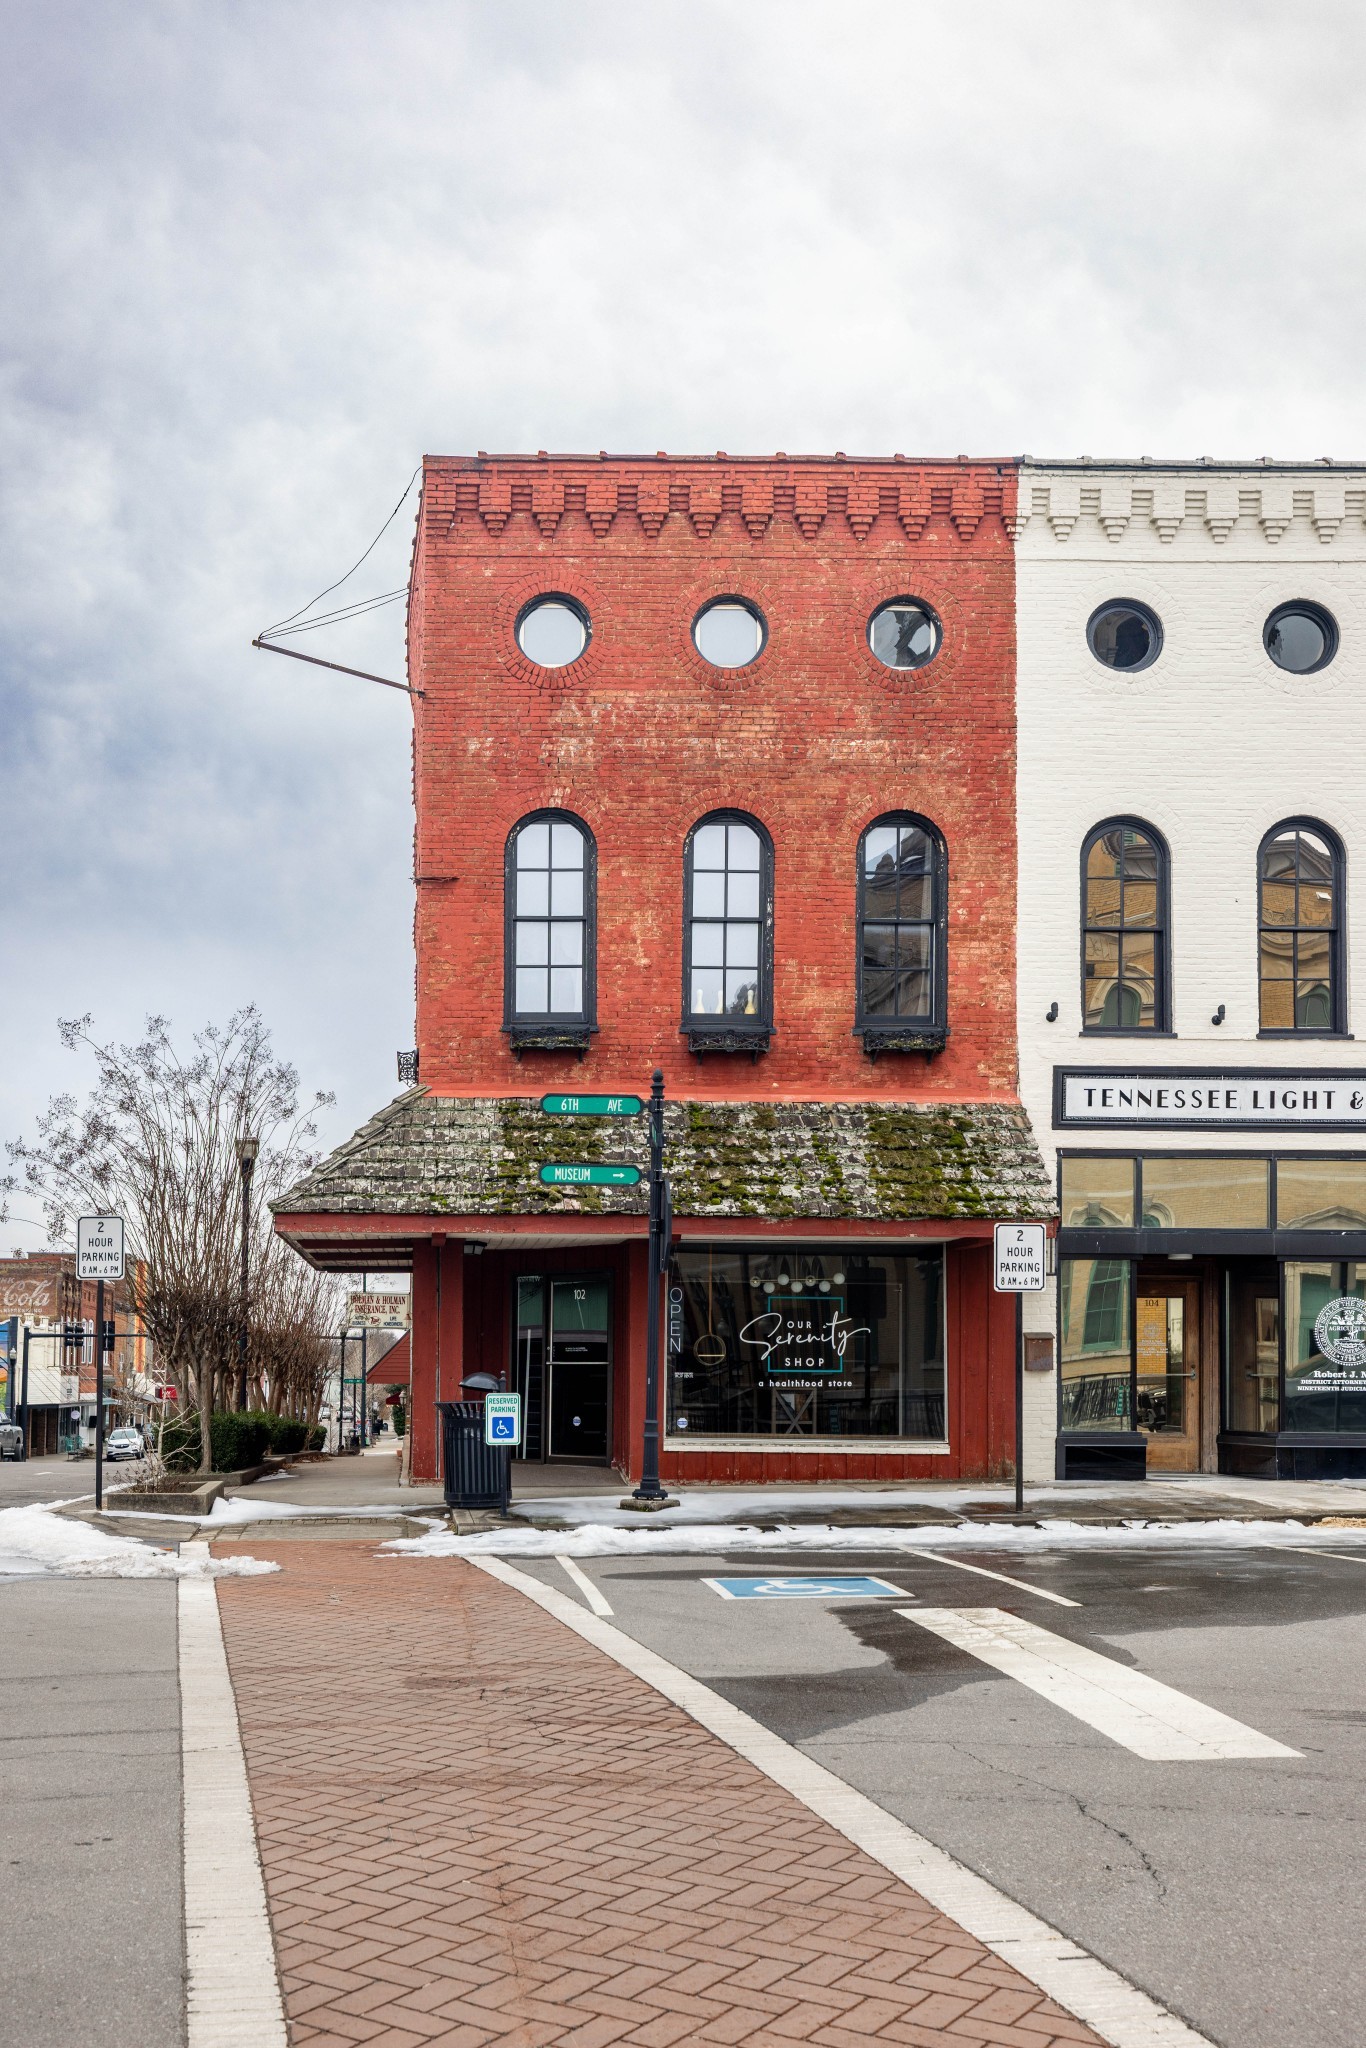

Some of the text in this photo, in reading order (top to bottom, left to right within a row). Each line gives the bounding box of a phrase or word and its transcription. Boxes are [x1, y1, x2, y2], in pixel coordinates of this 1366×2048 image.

[1084, 1088, 1364, 1110] TENNESSEE LIGHT &
[561, 1098, 623, 1112] 6TH AVE
[554, 1168, 591, 1181] MUSEUM
[98, 1221, 104, 1233] 2
[1017, 1229, 1024, 1242] 2
[88, 1238, 113, 1247] HOUR
[82, 1252, 119, 1261] PARKING
[1007, 1247, 1033, 1257] HOUR
[82, 1266, 119, 1274] 8 AM 6 PM
[1000, 1263, 1040, 1273] PARKING
[1001, 1277, 1040, 1286] 8 AM 6 PM
[573, 1289, 586, 1300] 102
[382, 1295, 406, 1305] HOLMAN
[669, 1287, 683, 1353] OPEN
[787, 1321, 812, 1329] OUR
[740, 1311, 871, 1360] Serenity
[785, 1358, 825, 1367] SHOP
[1313, 1370, 1347, 1378] Robert
[489, 1397, 518, 1405] RESERVED
